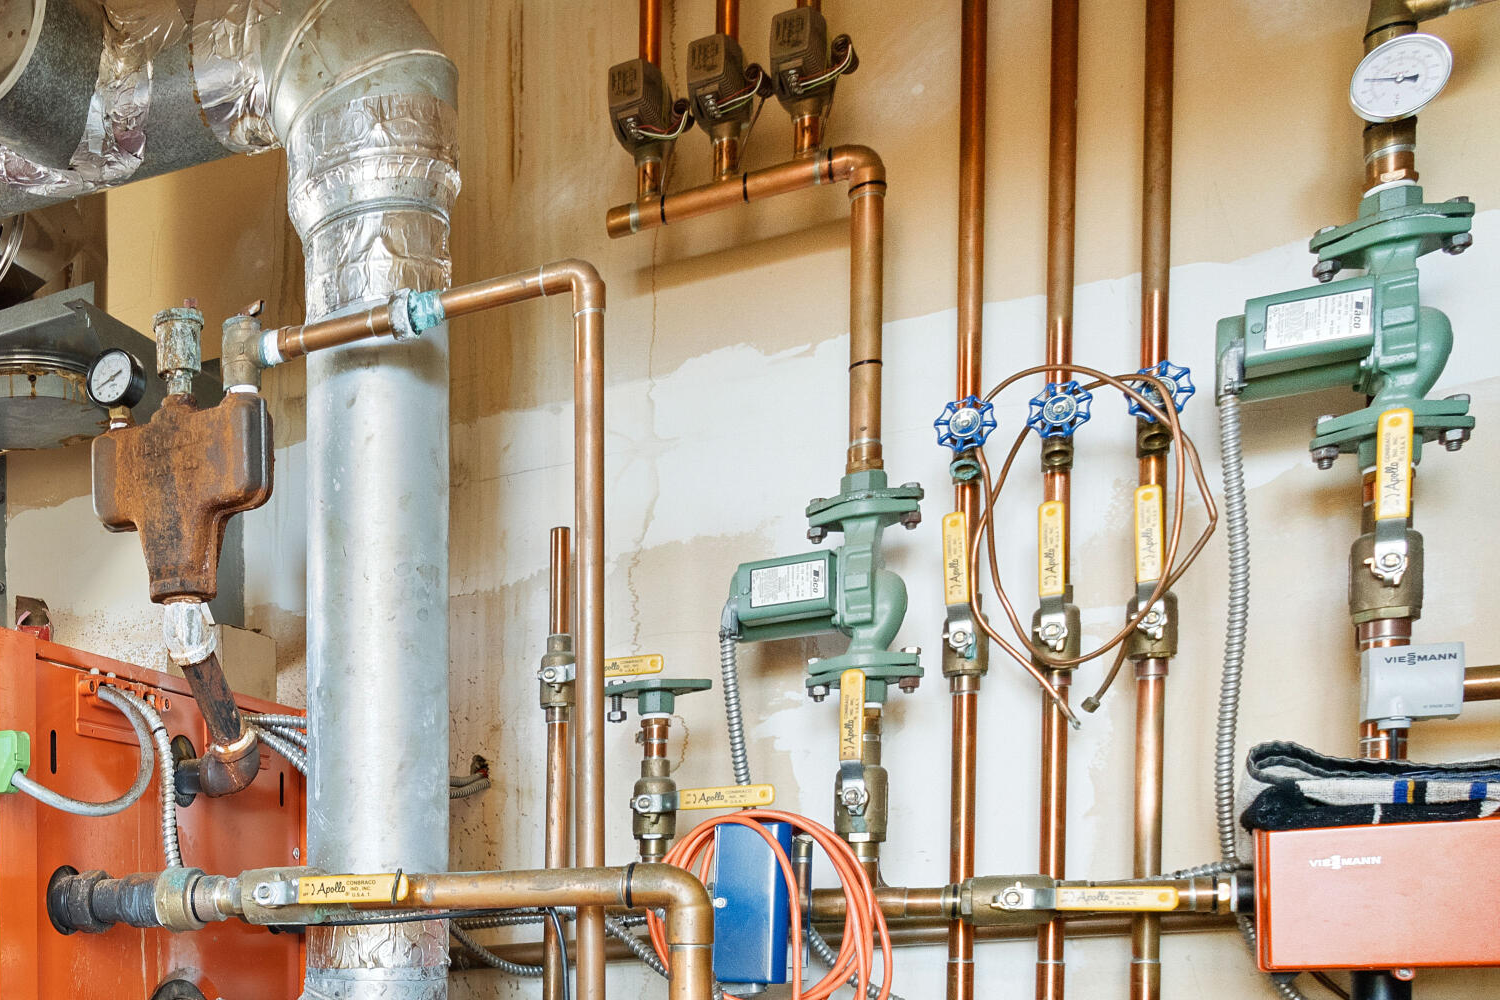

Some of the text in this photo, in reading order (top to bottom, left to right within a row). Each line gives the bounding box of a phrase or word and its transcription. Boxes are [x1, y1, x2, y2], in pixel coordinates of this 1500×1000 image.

[1384, 461, 1403, 491] Apollo
[1141, 527, 1158, 553] Apollo
[948, 558, 963, 584] Apollo
[1044, 548, 1060, 575] Apollo
[1384, 652, 1457, 666] VIESSMANN
[844, 719, 857, 745] Apollo
[698, 791, 725, 805] Apollo
[317, 881, 346, 898] Apollo
